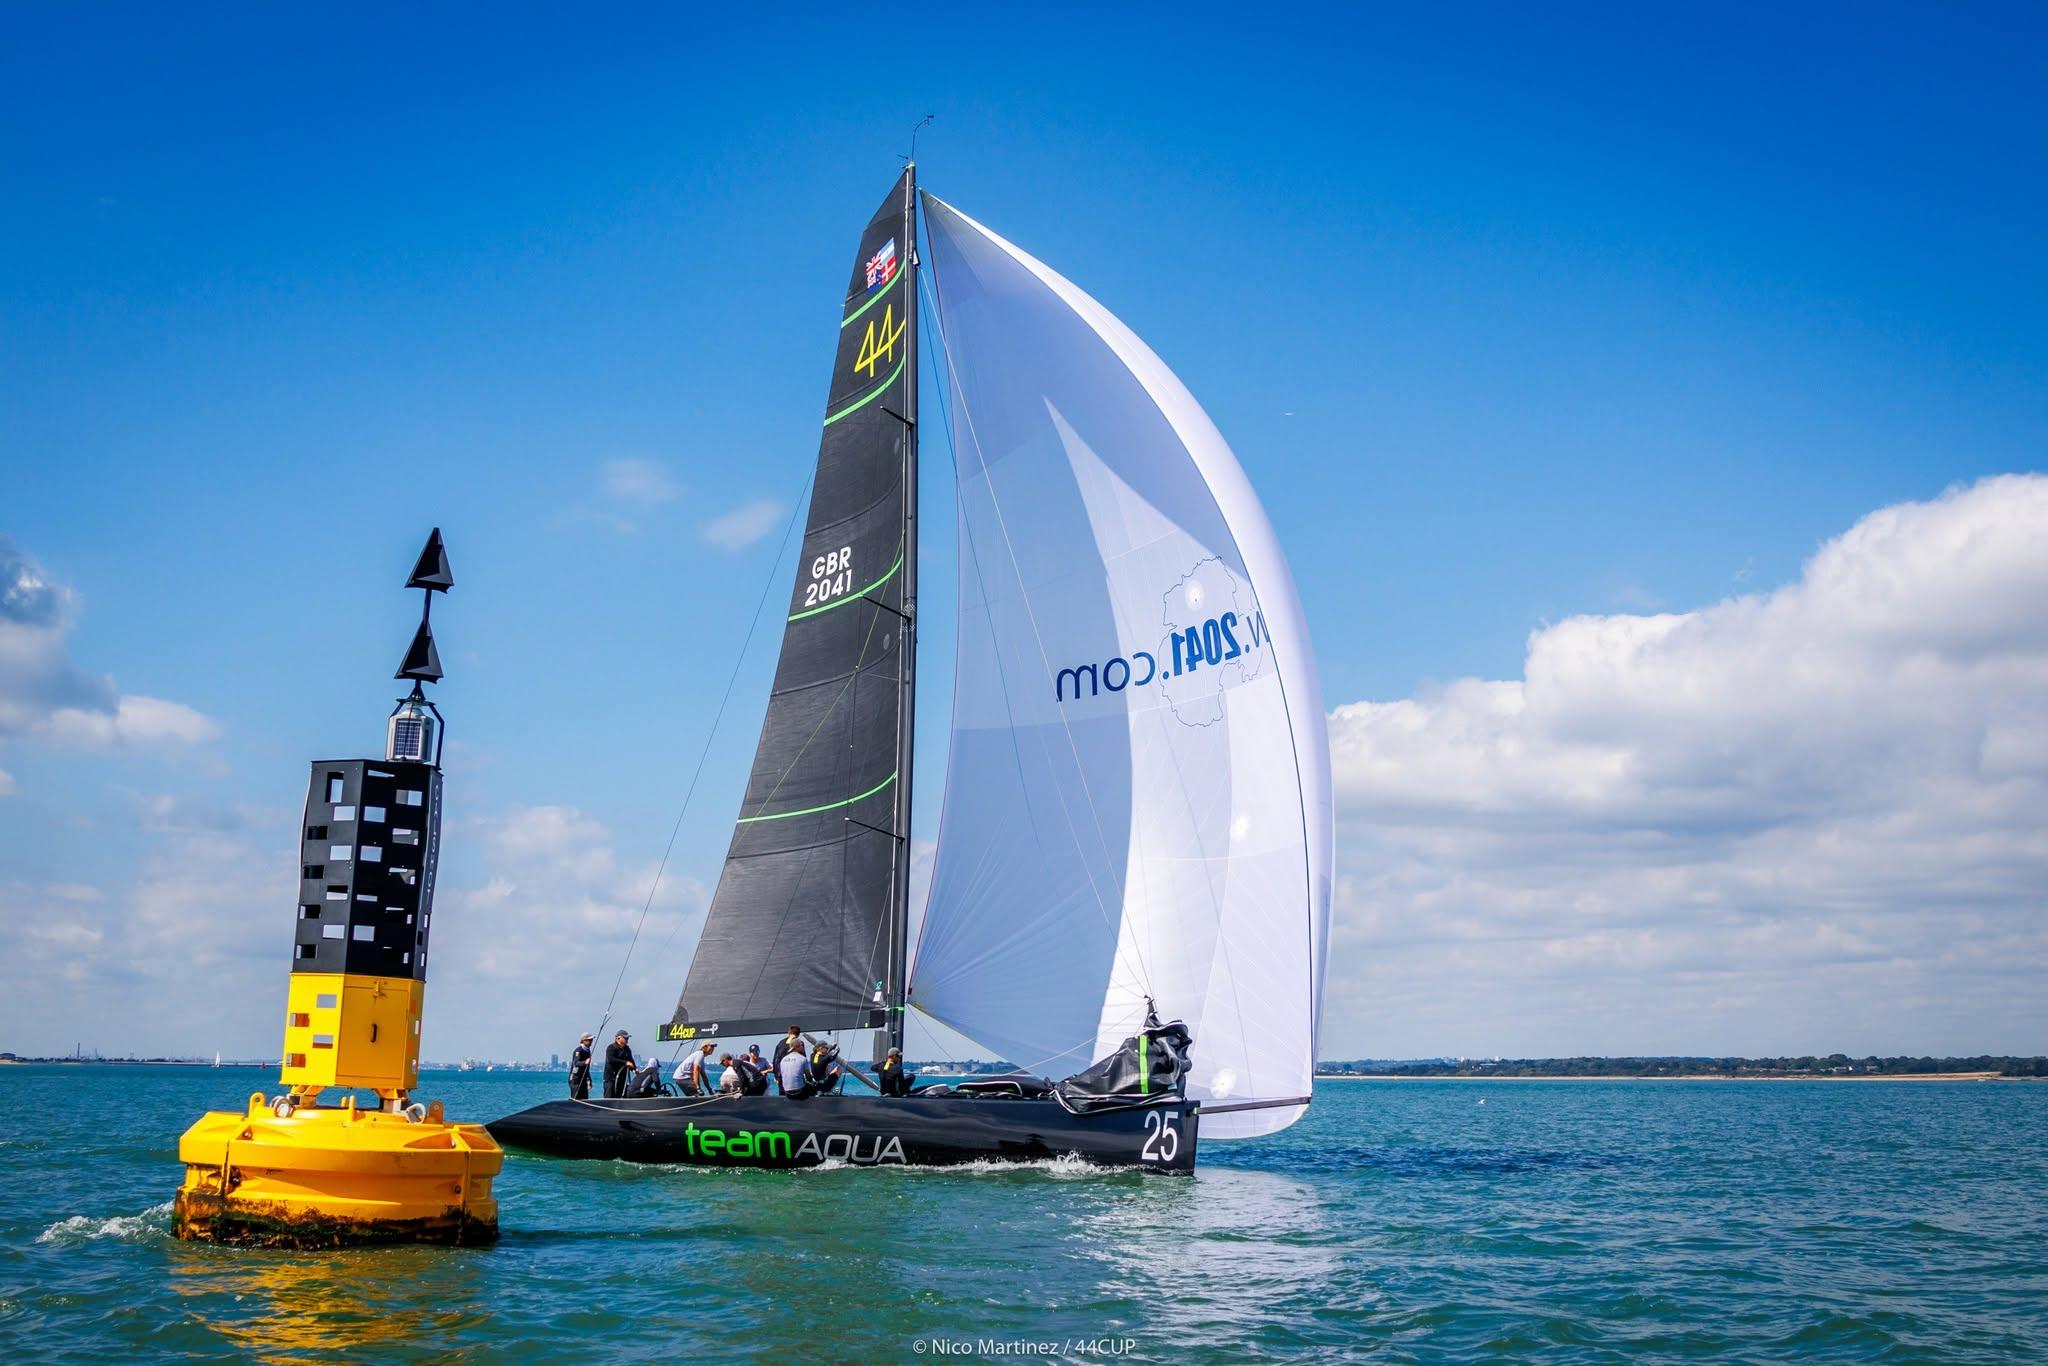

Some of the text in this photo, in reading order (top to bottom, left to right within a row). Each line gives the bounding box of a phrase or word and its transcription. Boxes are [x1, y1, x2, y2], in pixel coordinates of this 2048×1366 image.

[854, 304, 905, 377] 44
[812, 546, 851, 579] GBR
[805, 569, 852, 607] 2041
[670, 1023, 696, 1039] 44CUP
[685, 1122, 907, 1164] team AQUA
[1141, 1110, 1178, 1161] 25
